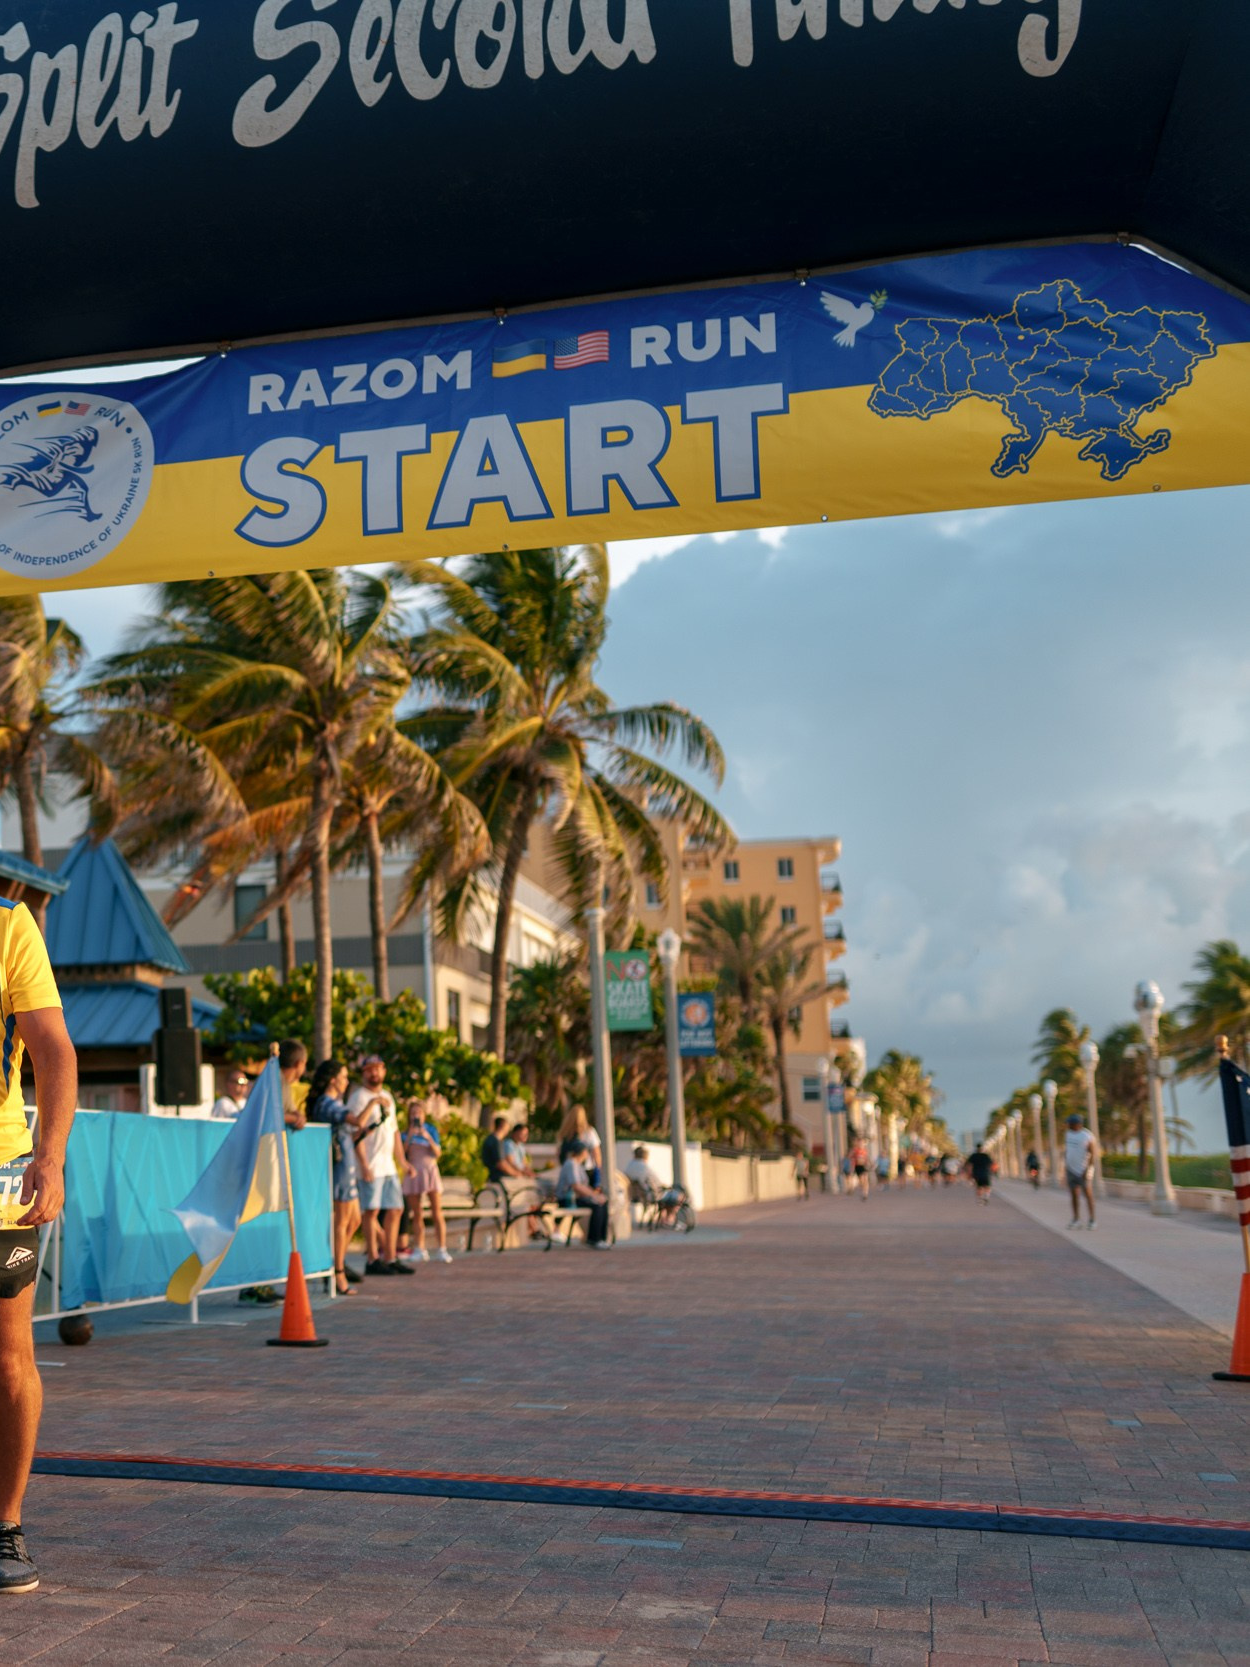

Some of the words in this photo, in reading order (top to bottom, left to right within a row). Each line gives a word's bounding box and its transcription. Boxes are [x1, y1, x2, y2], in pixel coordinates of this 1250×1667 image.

[247, 349, 473, 415] RAZOM
[629, 311, 777, 369] RUN
[93, 406, 126, 428] RUN
[131, 436, 143, 459] RUN
[132, 459, 143, 475] 5K
[234, 382, 790, 549] START
[111, 476, 141, 526] UKRAINE
[98, 526, 112, 542] OF
[13, 539, 98, 566] INDEPENDENCE
[607, 980, 649, 996] SKATE
